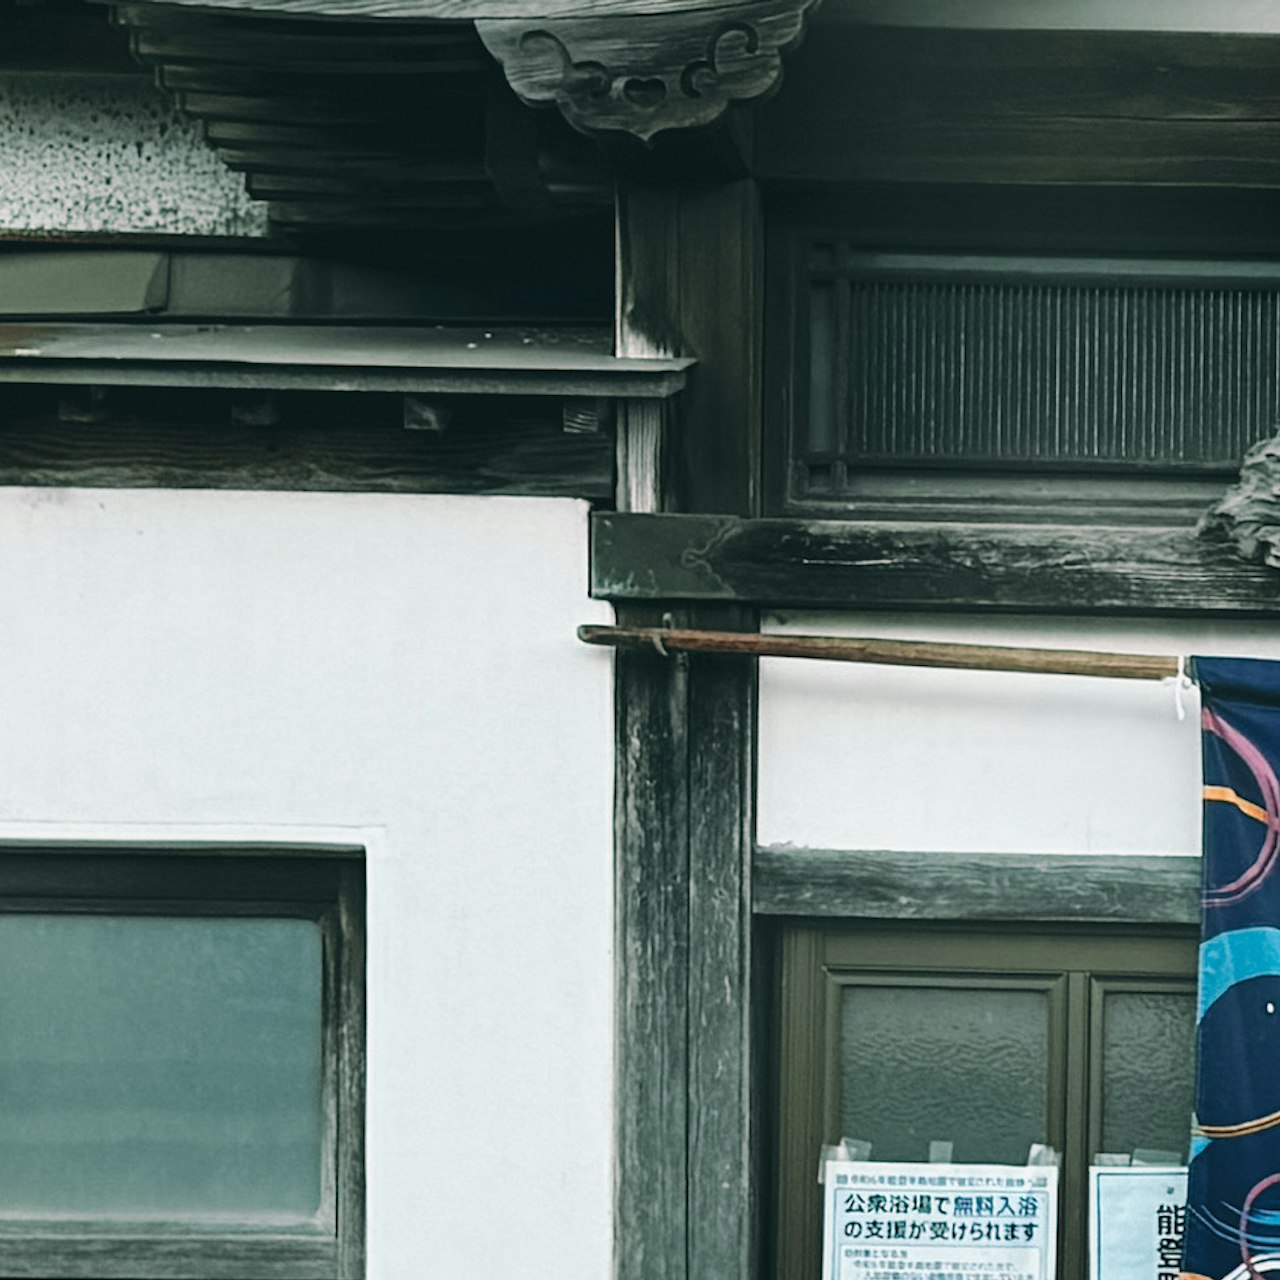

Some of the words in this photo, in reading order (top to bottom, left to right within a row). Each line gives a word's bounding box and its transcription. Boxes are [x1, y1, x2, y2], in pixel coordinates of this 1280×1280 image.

[845, 1194, 1038, 1216] 公衆浴場で無料入浴
[845, 1221, 1038, 1241] の支援が受けられます
